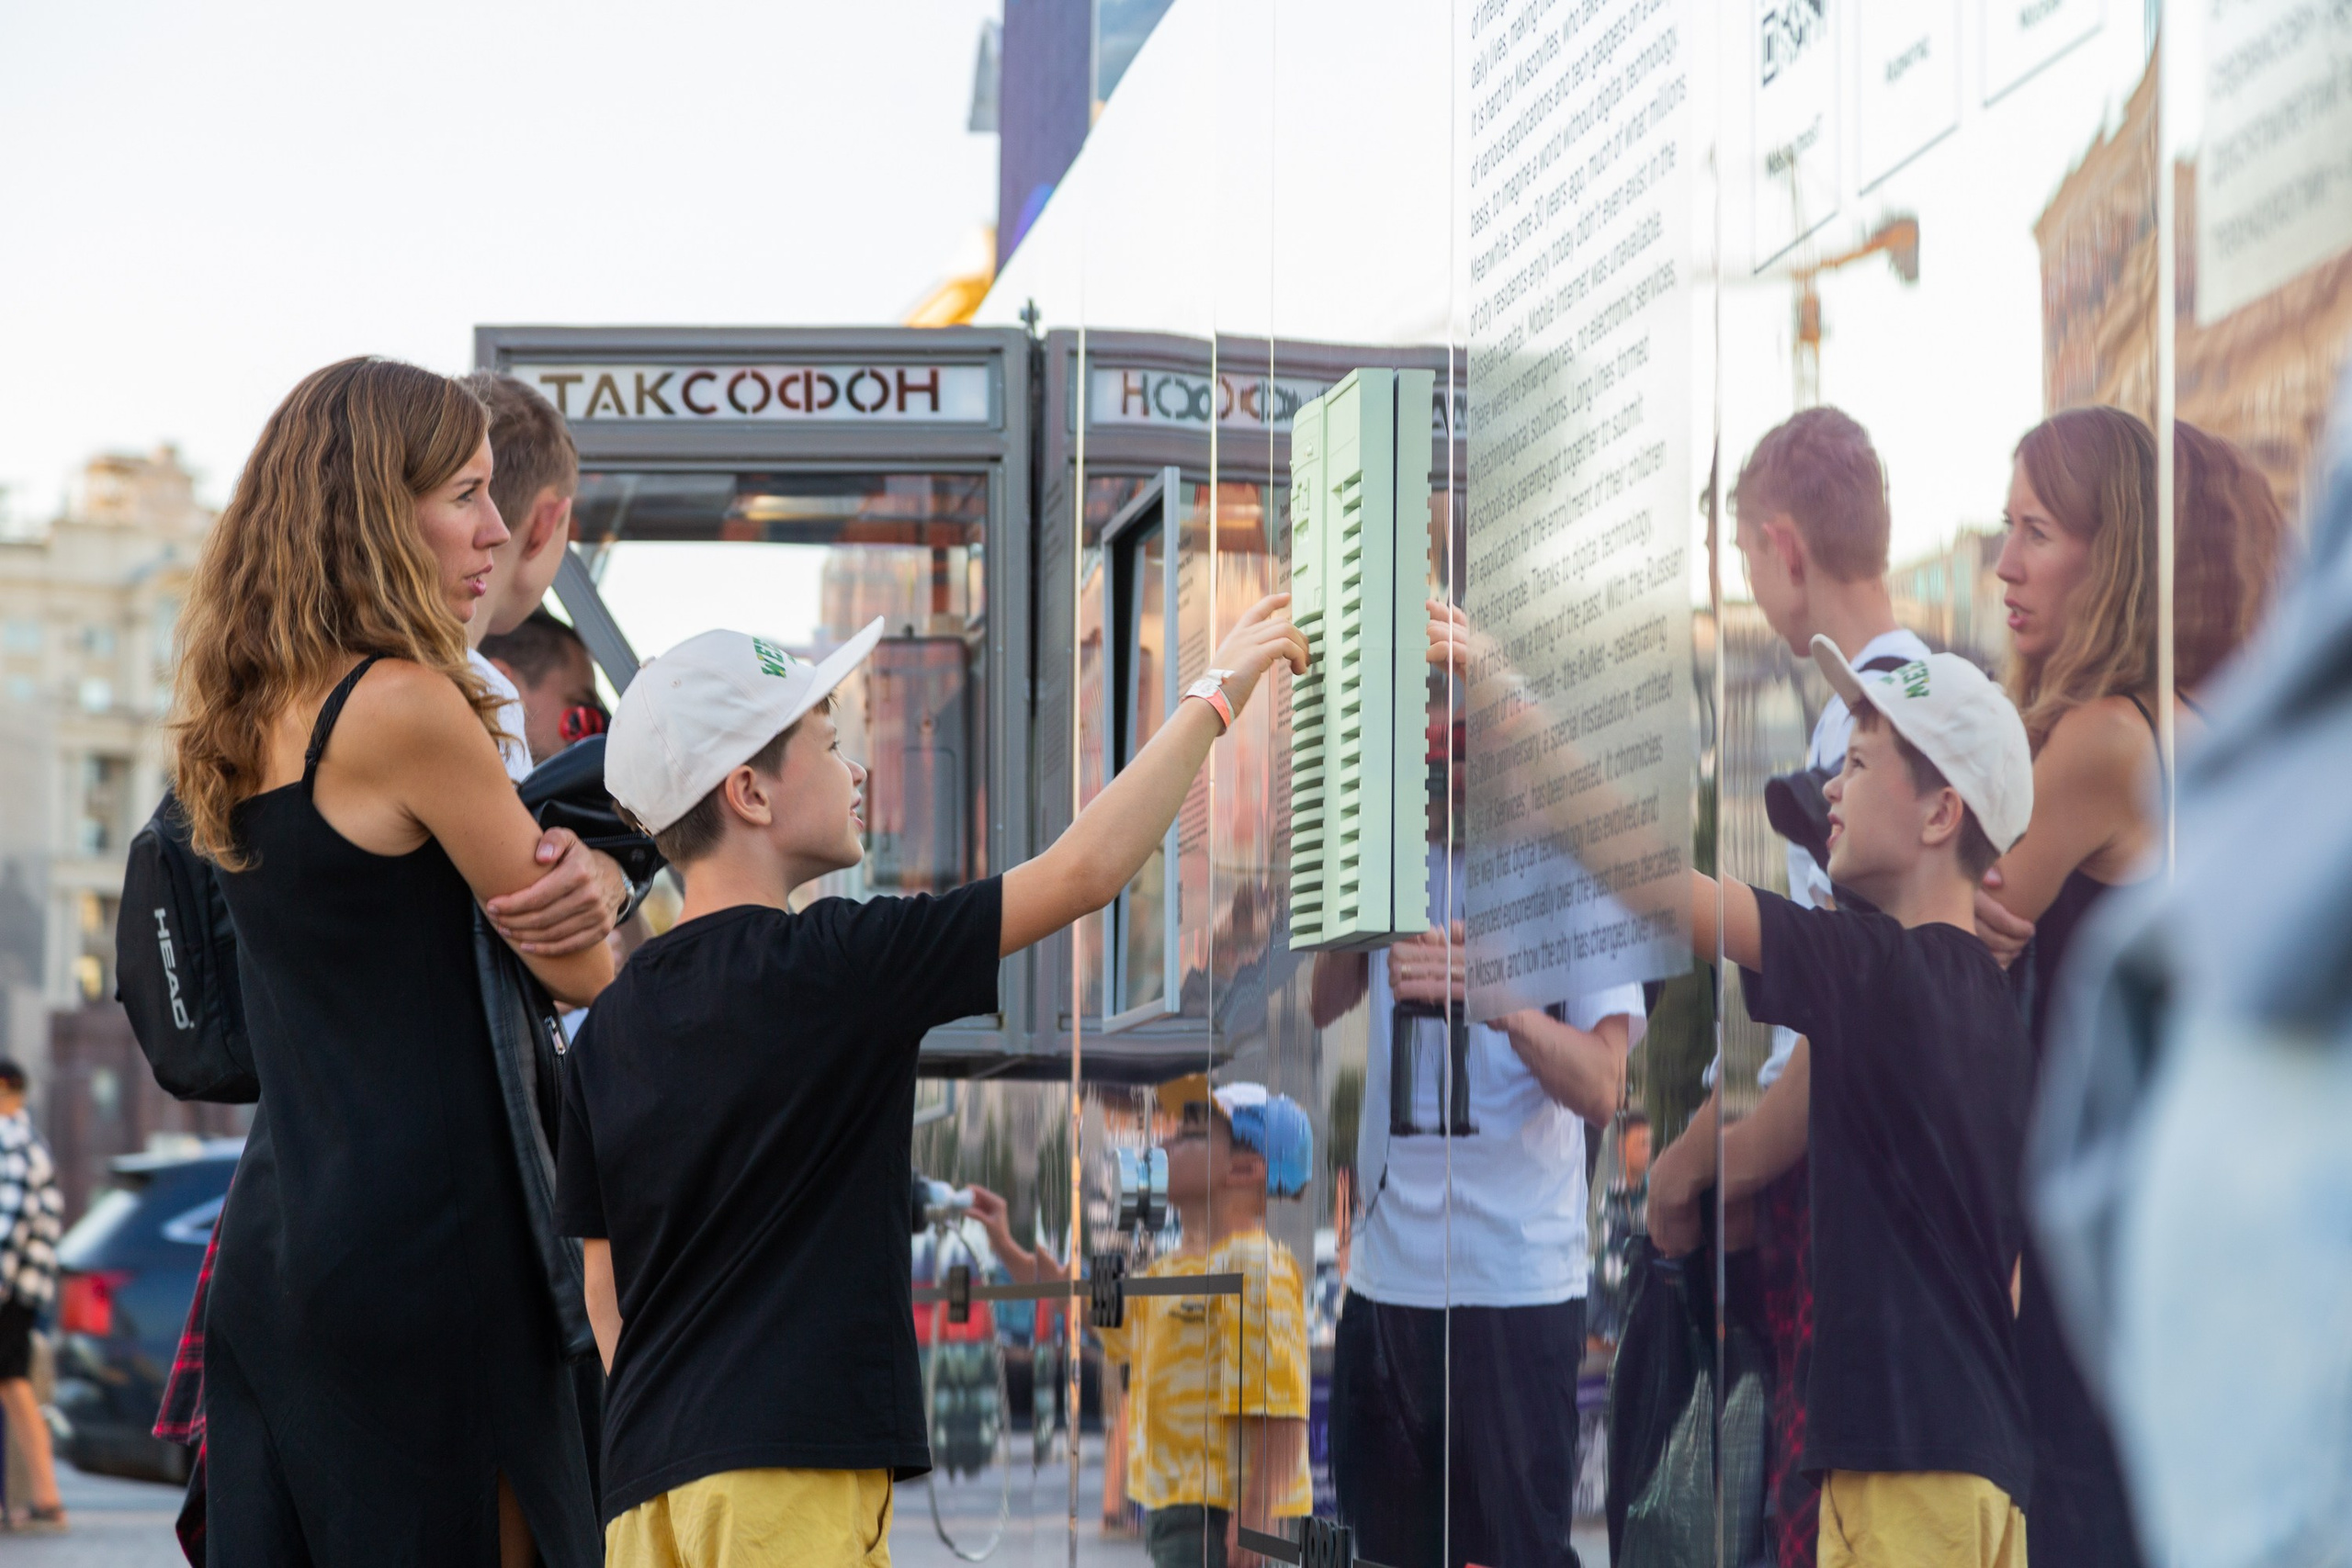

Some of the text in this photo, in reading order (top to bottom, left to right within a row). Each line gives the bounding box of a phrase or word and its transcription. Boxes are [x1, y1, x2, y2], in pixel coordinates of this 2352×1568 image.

[1472, 5, 1478, 39] of
[1472, 49, 1487, 89] daily
[1490, 32, 1508, 70] lives,
[1510, 0, 1537, 48] making
[1472, 108, 1476, 139] It
[1477, 102, 1484, 132] is
[1486, 81, 1501, 124] hard
[1503, 75, 1512, 107] for
[1516, 29, 1560, 94] Muscovites,
[1564, 6, 1578, 45] who
[1471, 153, 1477, 187] of
[1480, 135, 1504, 179] various
[1507, 88, 1552, 157] applications
[1555, 63, 1569, 107] and
[1572, 44, 1589, 90] tech
[1592, 16, 1625, 79] gadgets
[1629, 2, 1639, 34] on
[1471, 197, 1490, 237] basis,
[1493, 190, 1500, 217] to
[1502, 162, 1530, 209] imagine
[1532, 156, 1537, 181] a
[1539, 126, 1560, 175] world
[1564, 98, 1593, 152] without
[1597, 66, 1623, 124] digital
[1471, 230, 1510, 287] Meanwhile,
[1512, 212, 1532, 251] some
[1534, 195, 1543, 231] 30
[1546, 181, 1566, 230] years
[1589, 133, 1611, 183] much
[1614, 122, 1623, 161] of
[1625, 105, 1646, 151] what
[1650, 73, 1687, 130] millions
[1471, 302, 1477, 335] of
[1479, 295, 1491, 330] city
[1494, 267, 1527, 316] residents
[1530, 248, 1549, 288] enjoy
[1552, 229, 1573, 268] today
[1603, 186, 1623, 225] even
[1626, 162, 1646, 206] exist
[1650, 152, 1657, 186] in
[1660, 138, 1676, 178] the
[1471, 344, 1498, 387] Russian
[1499, 316, 1526, 366] capital.
[1529, 295, 1554, 341] Mobile
[1556, 266, 1589, 319] Internet
[1591, 255, 1607, 290] was
[1471, 401, 1489, 436] There
[1492, 387, 1509, 420] were
[1511, 378, 1520, 406] no
[1521, 337, 1575, 398] smartphones,
[1577, 327, 1586, 355] no
[1590, 287, 1634, 346] electronic
[539, 368, 941, 418] ТАКСОФОН
[1470, 328, 1649, 487] no technological solutions. Long lines formed
[1469, 390, 1643, 536] at schools as parents got together to submit
[1469, 440, 1667, 586] an application for the enrollment of their children
[1469, 606, 1476, 636] in
[1476, 600, 1488, 632] the
[1490, 591, 1504, 624] first
[1507, 576, 1530, 623] grade.
[1532, 557, 1559, 600] Thanks
[1562, 555, 1569, 582] to
[1573, 531, 1599, 581] digital
[1479, 649, 1487, 681] of
[1488, 643, 1500, 676] this
[1503, 638, 1509, 669] is
[1510, 635, 1525, 664] now
[1528, 631, 1532, 655] a
[1534, 616, 1555, 652] thing
[1556, 605, 1565, 639] of
[1566, 600, 1579, 634] the
[1607, 571, 1626, 613] With
[1629, 565, 1644, 601] the
[1647, 545, 1684, 592] Russian
[1500, 689, 1508, 721] of
[1510, 684, 1521, 717] the
[1523, 669, 1555, 710] Internet
[1563, 657, 1577, 691] the
[1579, 643, 1605, 682] RuNet
[1614, 614, 1667, 665] celebrating
[1544, 729, 1548, 753] a
[1550, 707, 1578, 757] special
[1581, 688, 1634, 737] installation,
[1635, 663, 1673, 712] entitled
[1468, 788, 1658, 889] the way that digital technology has evolved and
[1486, 798, 1493, 829] of
[1532, 780, 1545, 811] has
[1547, 773, 1566, 806] been
[1569, 752, 1604, 796] created.
[1607, 750, 1612, 782] It
[1615, 731, 1663, 778] chronicles
[1467, 960, 1474, 988] in
[1476, 956, 1505, 987] Moscow,
[1507, 945, 1521, 978] and
[1523, 942, 1538, 974] how
[1541, 937, 1554, 969] the
[1556, 932, 1571, 971] city
[1574, 928, 1588, 960] has
[1590, 913, 1628, 959] changed
[1631, 915, 1652, 944] over
[1468, 842, 1681, 943] expanded exponentially over the past three decades
[153, 908, 191, 1030] HEAD
